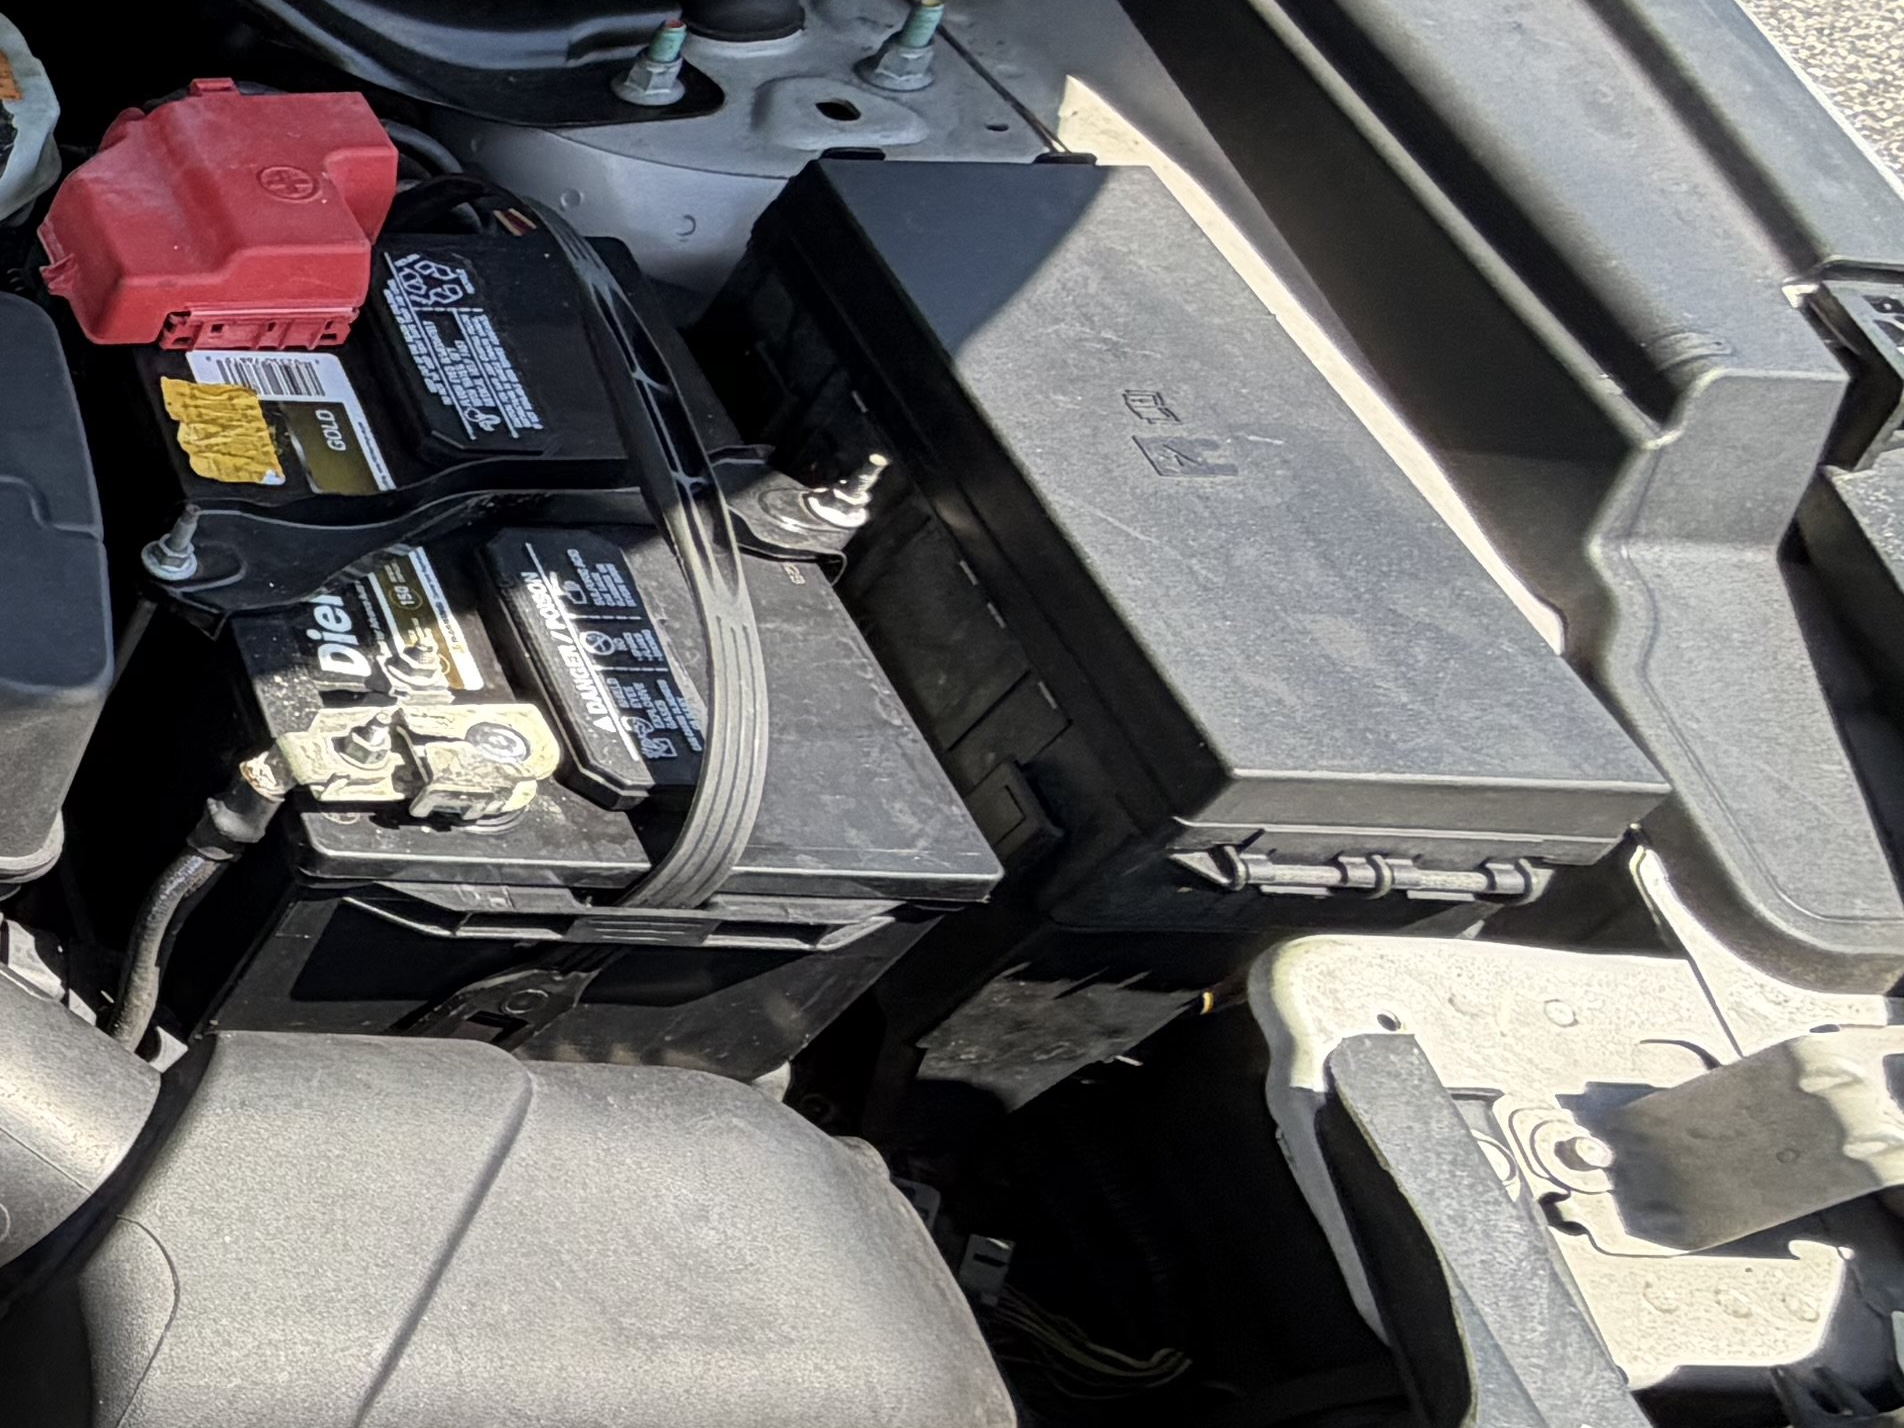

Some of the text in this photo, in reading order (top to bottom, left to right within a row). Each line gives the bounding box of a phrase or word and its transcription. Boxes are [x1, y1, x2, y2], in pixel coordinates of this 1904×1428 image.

[315, 409, 347, 452] GOLD
[394, 586, 415, 606] 150
[520, 571, 566, 630] POISON
[558, 643, 608, 715] DANGER
